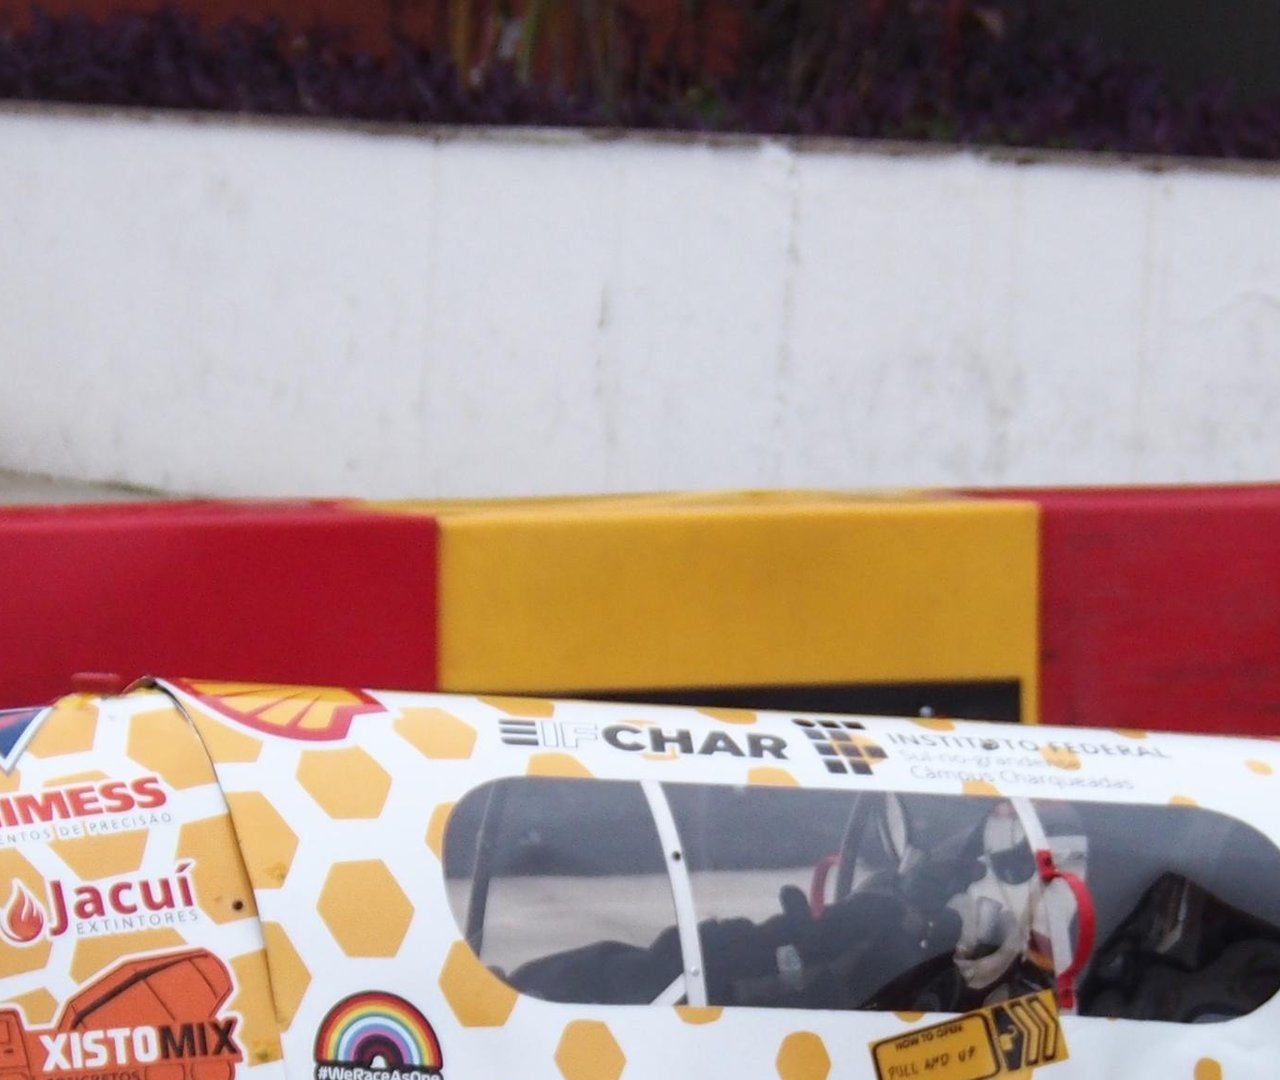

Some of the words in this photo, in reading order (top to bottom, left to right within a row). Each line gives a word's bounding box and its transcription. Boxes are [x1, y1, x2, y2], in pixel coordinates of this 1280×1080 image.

[60, 824, 81, 838] DE
[88, 811, 173, 835] PRECISÃO
[49, 861, 194, 937] Jacuí
[76, 909, 199, 936] EXTINTORES
[39, 1016, 239, 1072] XISTOMIX
[895, 1036, 920, 1052] HOW
[920, 1031, 933, 1043] TO
